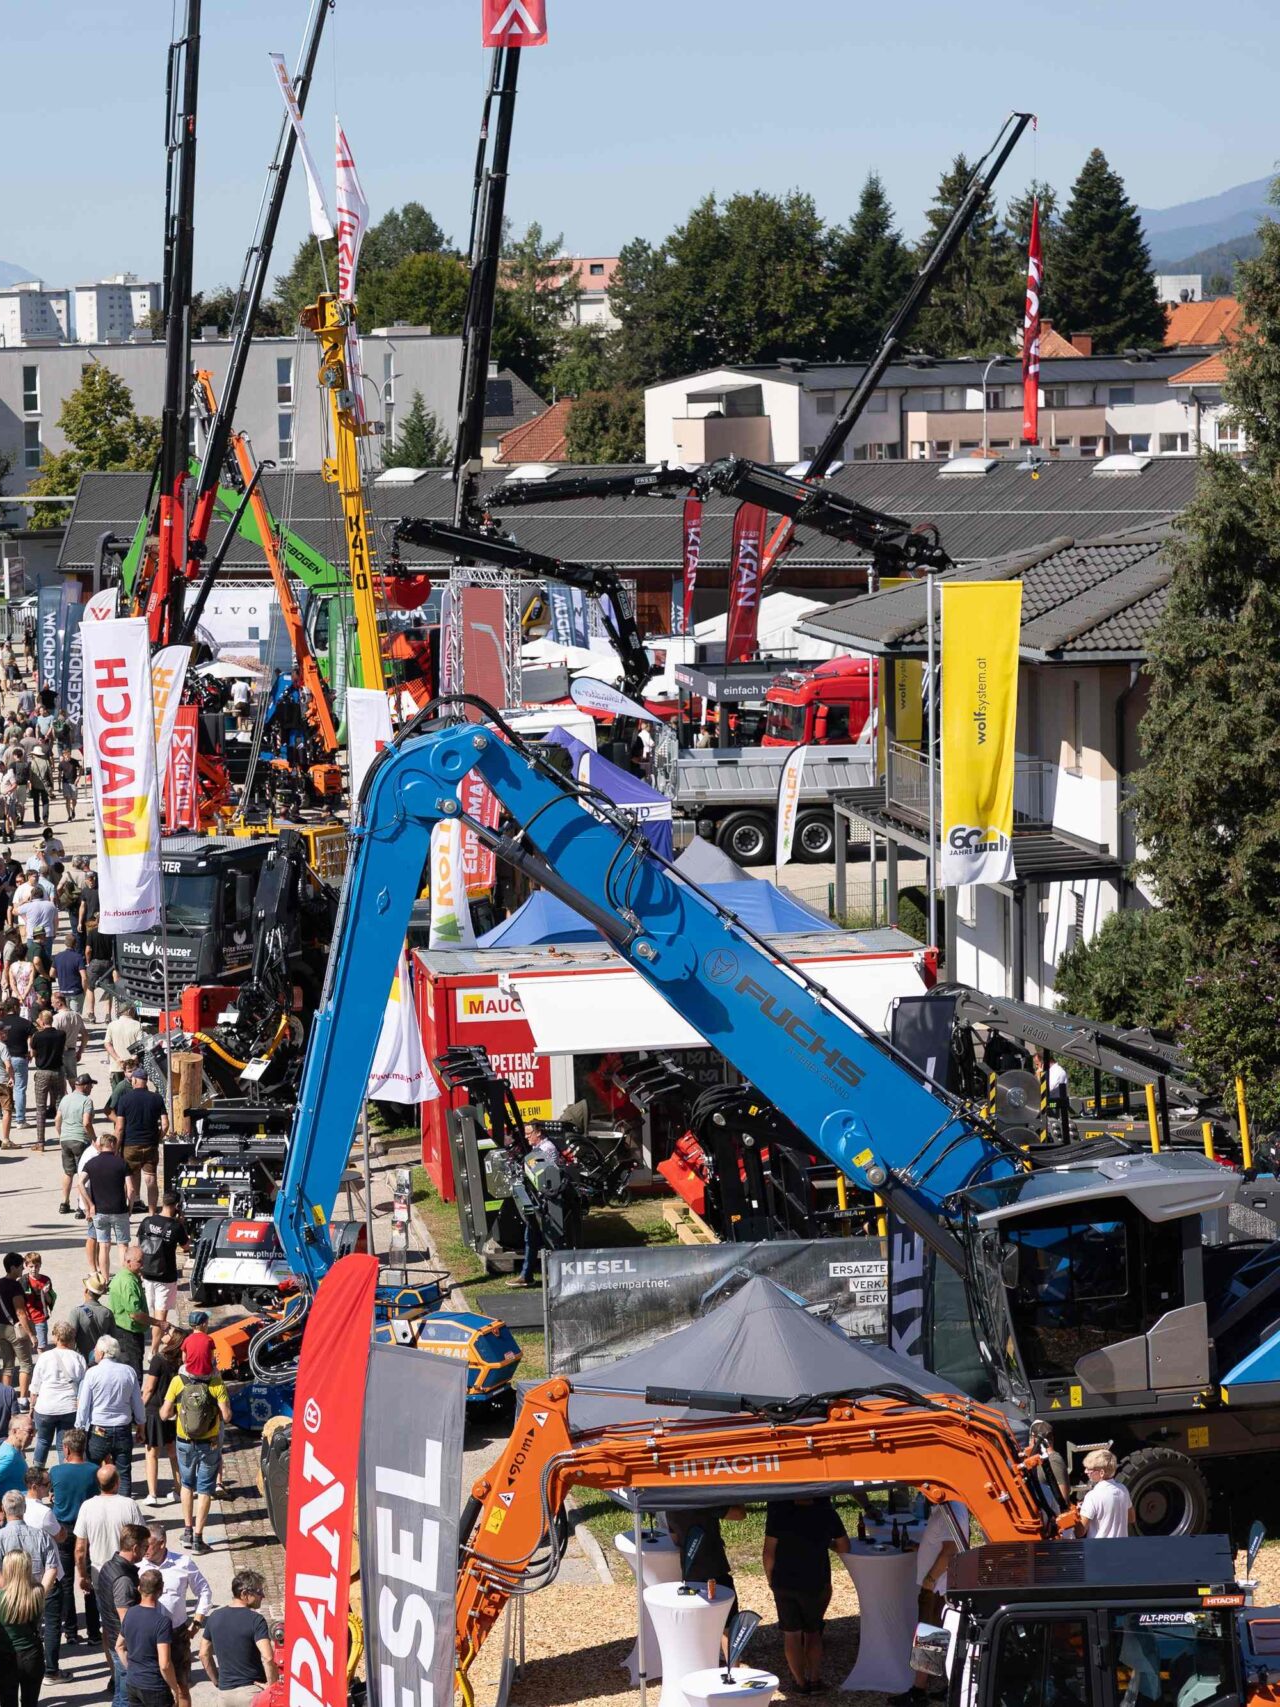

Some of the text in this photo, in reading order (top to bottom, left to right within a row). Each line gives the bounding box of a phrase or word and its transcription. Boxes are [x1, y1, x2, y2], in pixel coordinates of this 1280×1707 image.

[723, 685, 758, 695] einfach
[973, 657, 991, 745] wolfsystem.at
[171, 732, 193, 826] MARREL
[123, 942, 192, 957] Fritz Kreuzer
[469, 999, 521, 1014] MAUC
[734, 974, 868, 1088] FUCHS
[561, 1259, 637, 1275] KIESEL
[832, 1264, 887, 1275] ERSATZTE
[561, 1279, 670, 1292] Mein Systempartner.
[859, 1294, 887, 1304] SERV
[510, 1437, 533, 1476] 90m
[669, 1453, 781, 1478] HITACHI
[1206, 1597, 1240, 1605] HITACHI
[732, 1625, 747, 1649] KIESEL
